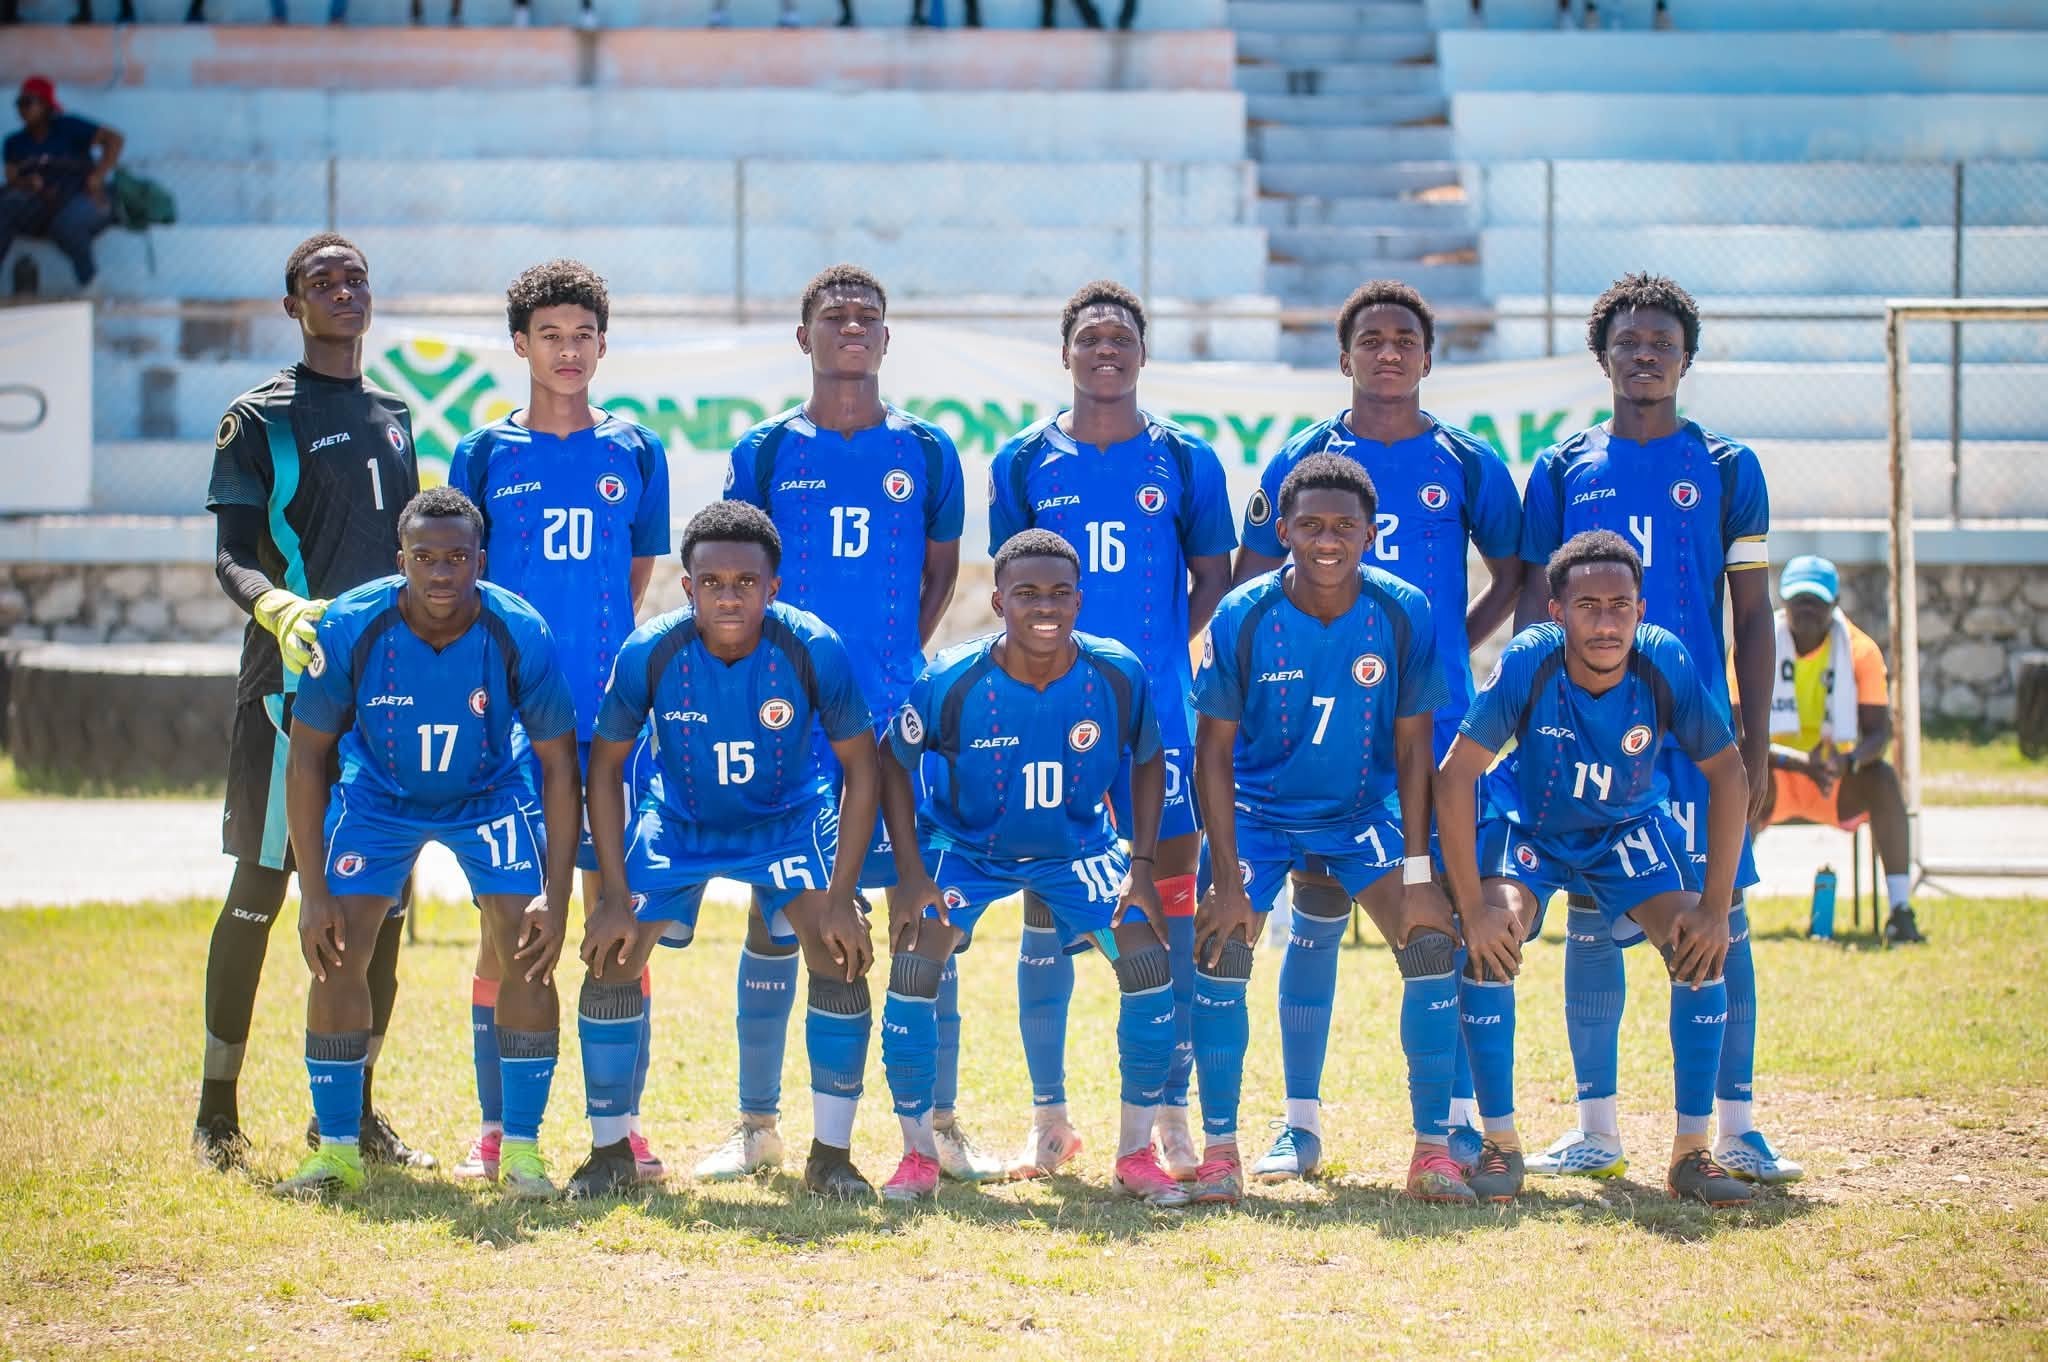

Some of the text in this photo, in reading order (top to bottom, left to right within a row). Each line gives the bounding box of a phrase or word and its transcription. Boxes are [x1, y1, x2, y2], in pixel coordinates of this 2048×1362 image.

[309, 431, 350, 452] SAETA
[367, 458, 384, 510] 1
[493, 481, 542, 499] SAETA
[777, 480, 826, 491] SAETA
[1036, 495, 1080, 511] SAETA
[1572, 487, 1616, 505] SAETA
[543, 507, 593, 560] 20
[829, 506, 870, 558] 13
[1085, 521, 1126, 573] 16
[1629, 515, 1652, 567] 4
[1257, 669, 1304, 682] SAETA
[366, 695, 414, 707] SAETA
[662, 710, 708, 723] SAETA
[1311, 696, 1336, 745] 7
[417, 724, 459, 772] 17
[713, 740, 755, 785] 15
[969, 736, 1020, 749] SAETA
[1022, 761, 1063, 810] 10
[1573, 761, 1612, 800] 14
[476, 814, 517, 867] 17
[1354, 825, 1387, 862] 7
[1672, 801, 1694, 852] 4
[768, 855, 816, 889] 15
[1612, 827, 1659, 878] 14
[1072, 854, 1121, 902] 10
